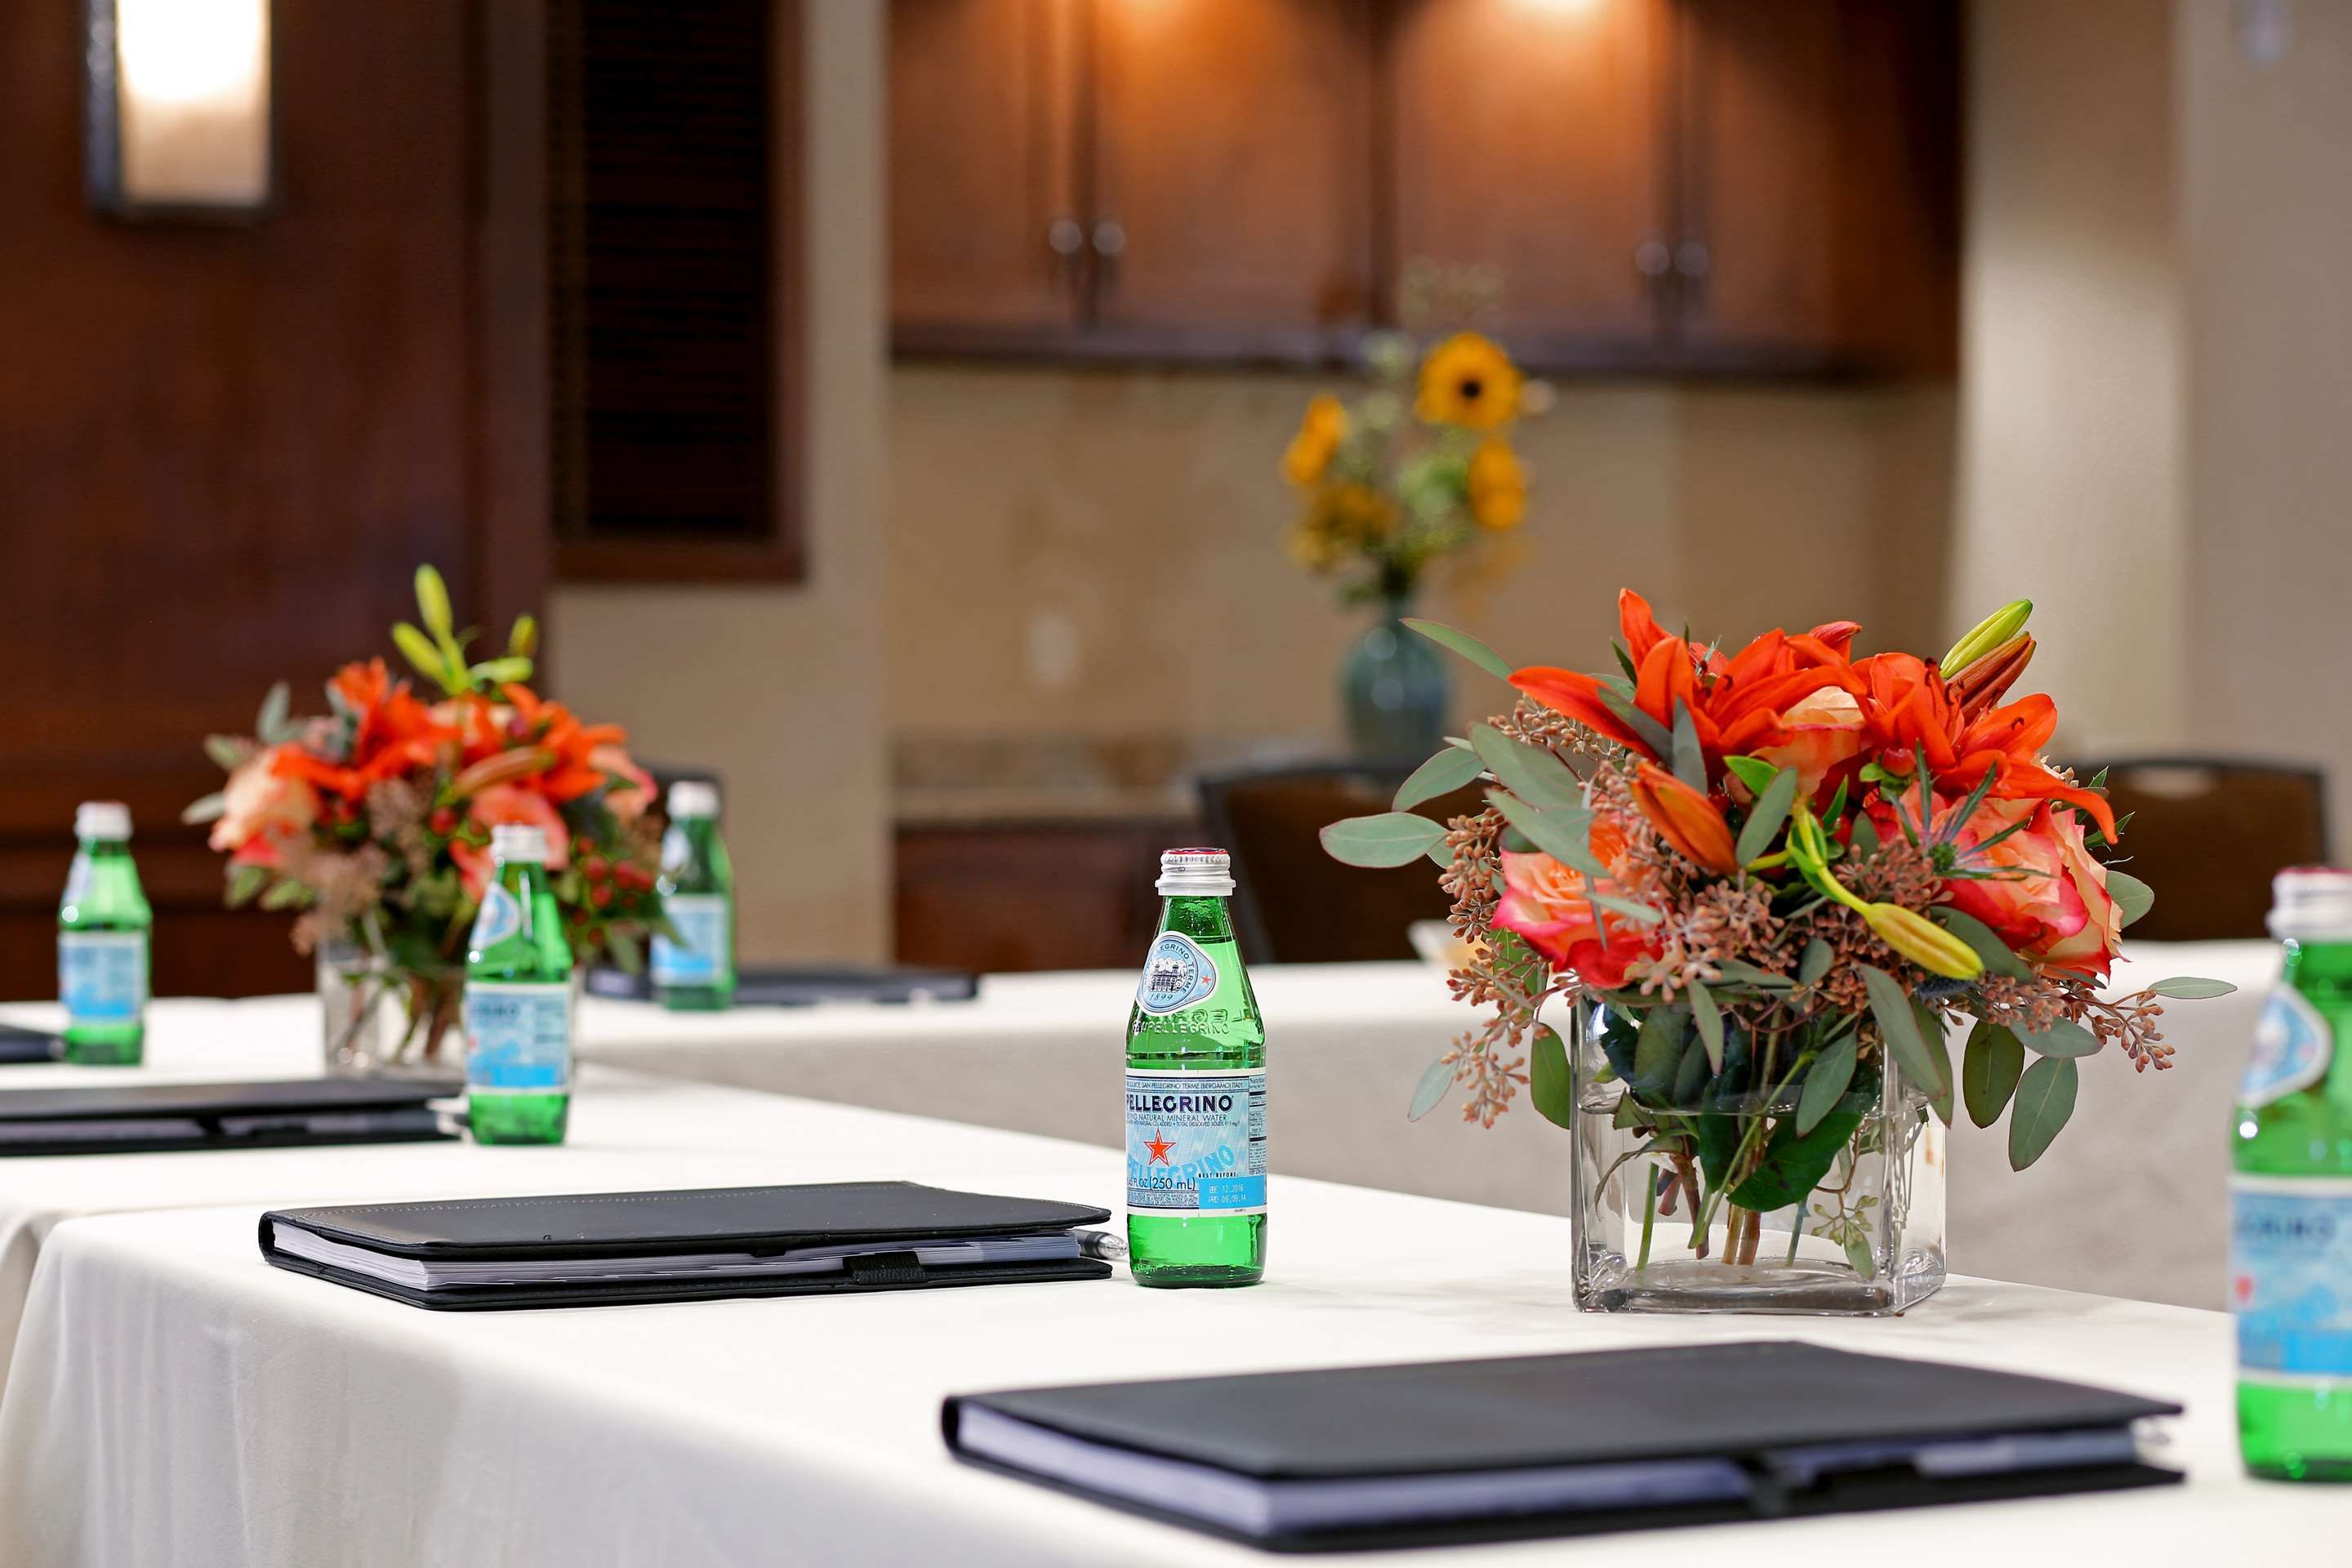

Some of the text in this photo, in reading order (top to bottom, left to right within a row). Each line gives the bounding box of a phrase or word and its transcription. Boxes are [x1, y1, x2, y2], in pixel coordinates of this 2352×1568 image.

[1158, 943, 1190, 960] EGRINO
[1176, 961, 1195, 995] TERME
[1149, 993, 1173, 1001] 1899
[1139, 1113, 1165, 1121] NATURAL
[1166, 1114, 1200, 1122] MINERAL
[1203, 1114, 1227, 1122] WATER
[1138, 1178, 1148, 1187] OZ
[1149, 1176, 1174, 1190] (250
[1176, 1177, 1196, 1191] mL)
